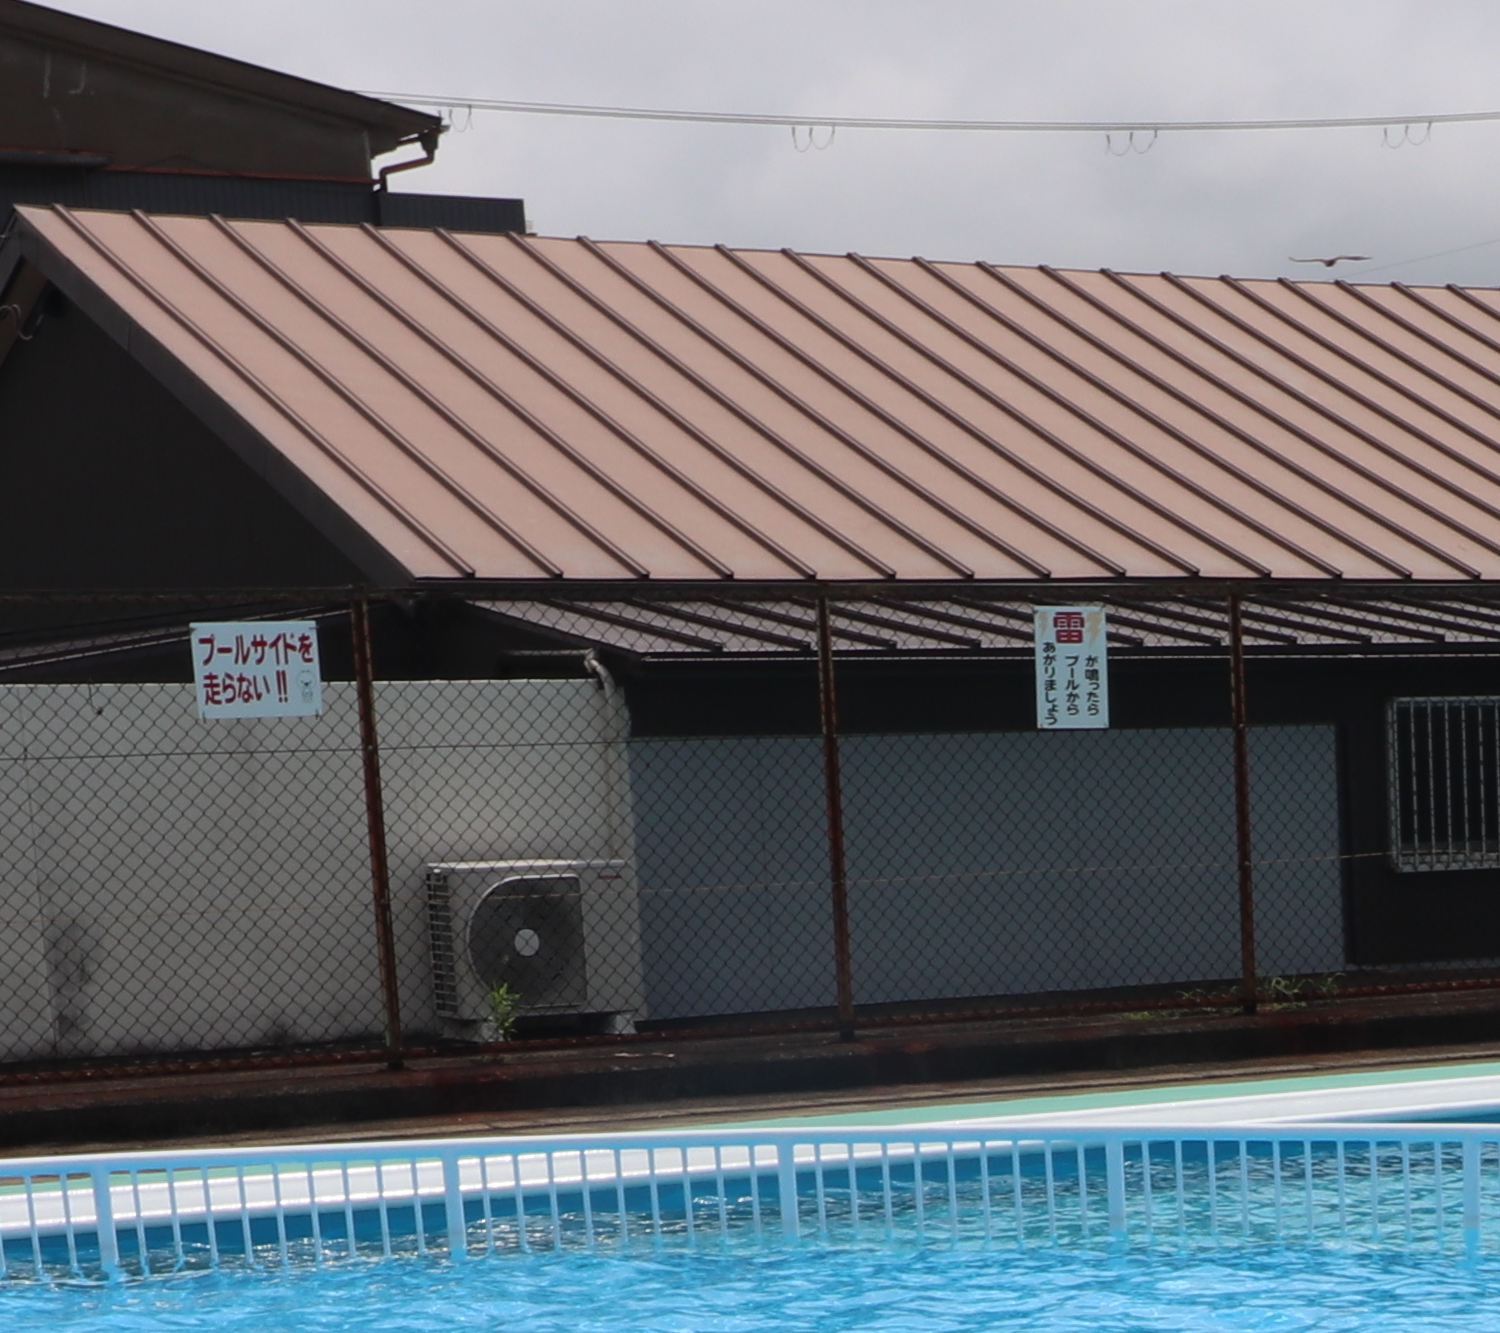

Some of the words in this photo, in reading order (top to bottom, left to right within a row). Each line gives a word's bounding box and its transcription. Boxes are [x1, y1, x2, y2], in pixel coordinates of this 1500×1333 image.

[198, 632, 314, 666] プールサイドを
[1053, 611, 1085, 643] 雷
[1043, 642, 1058, 726] あがりましょう
[1065, 655, 1080, 716] プールから
[1084, 655, 1100, 716] が鳴ったら
